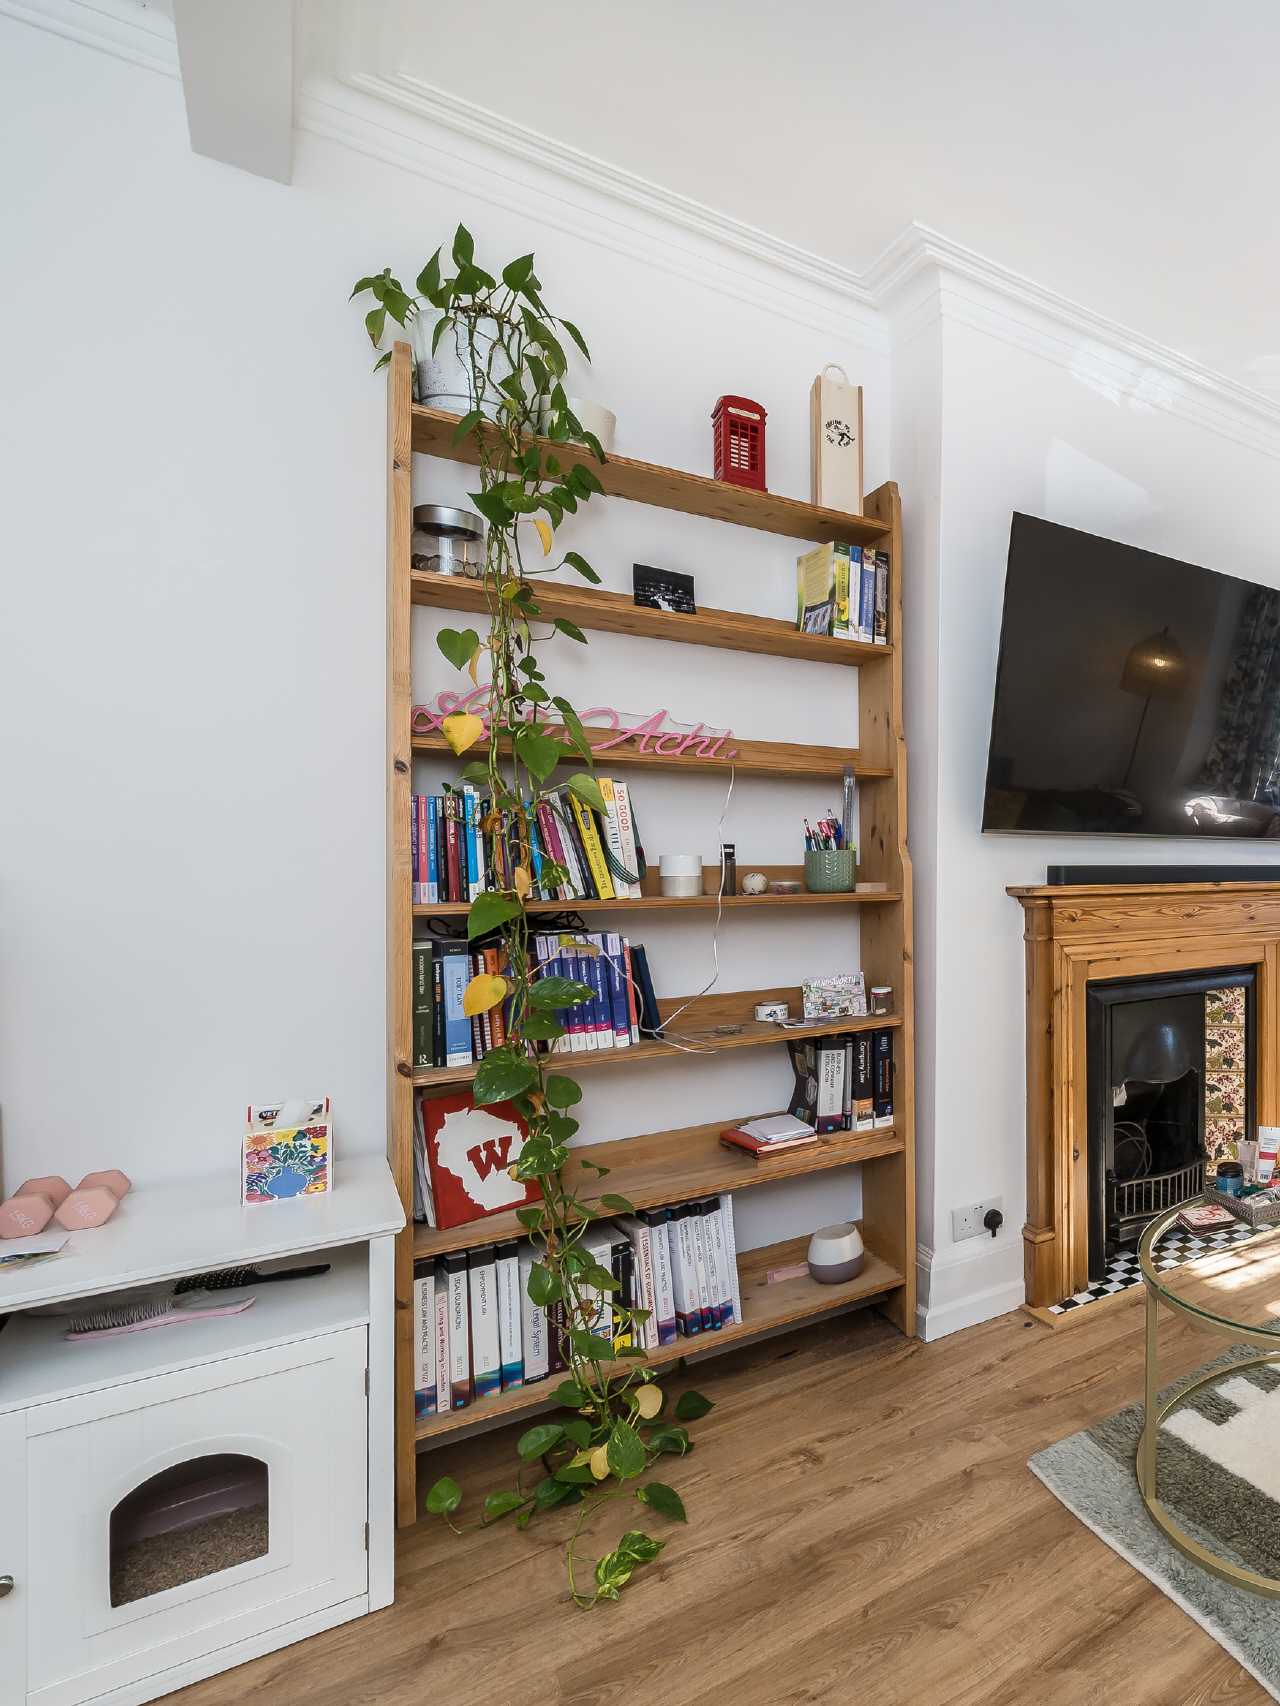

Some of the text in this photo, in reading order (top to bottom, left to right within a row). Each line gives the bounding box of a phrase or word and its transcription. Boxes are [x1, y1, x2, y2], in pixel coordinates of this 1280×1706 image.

[616, 789, 625, 802] SO
[619, 804, 630, 832] GOOD
[858, 1041, 867, 1070] Company
[466, 1135, 513, 1183] W
[642, 1239, 650, 1272] ESSENTIALS
[531, 1308, 543, 1357] Legal System
[438, 1338, 446, 1363] Working
